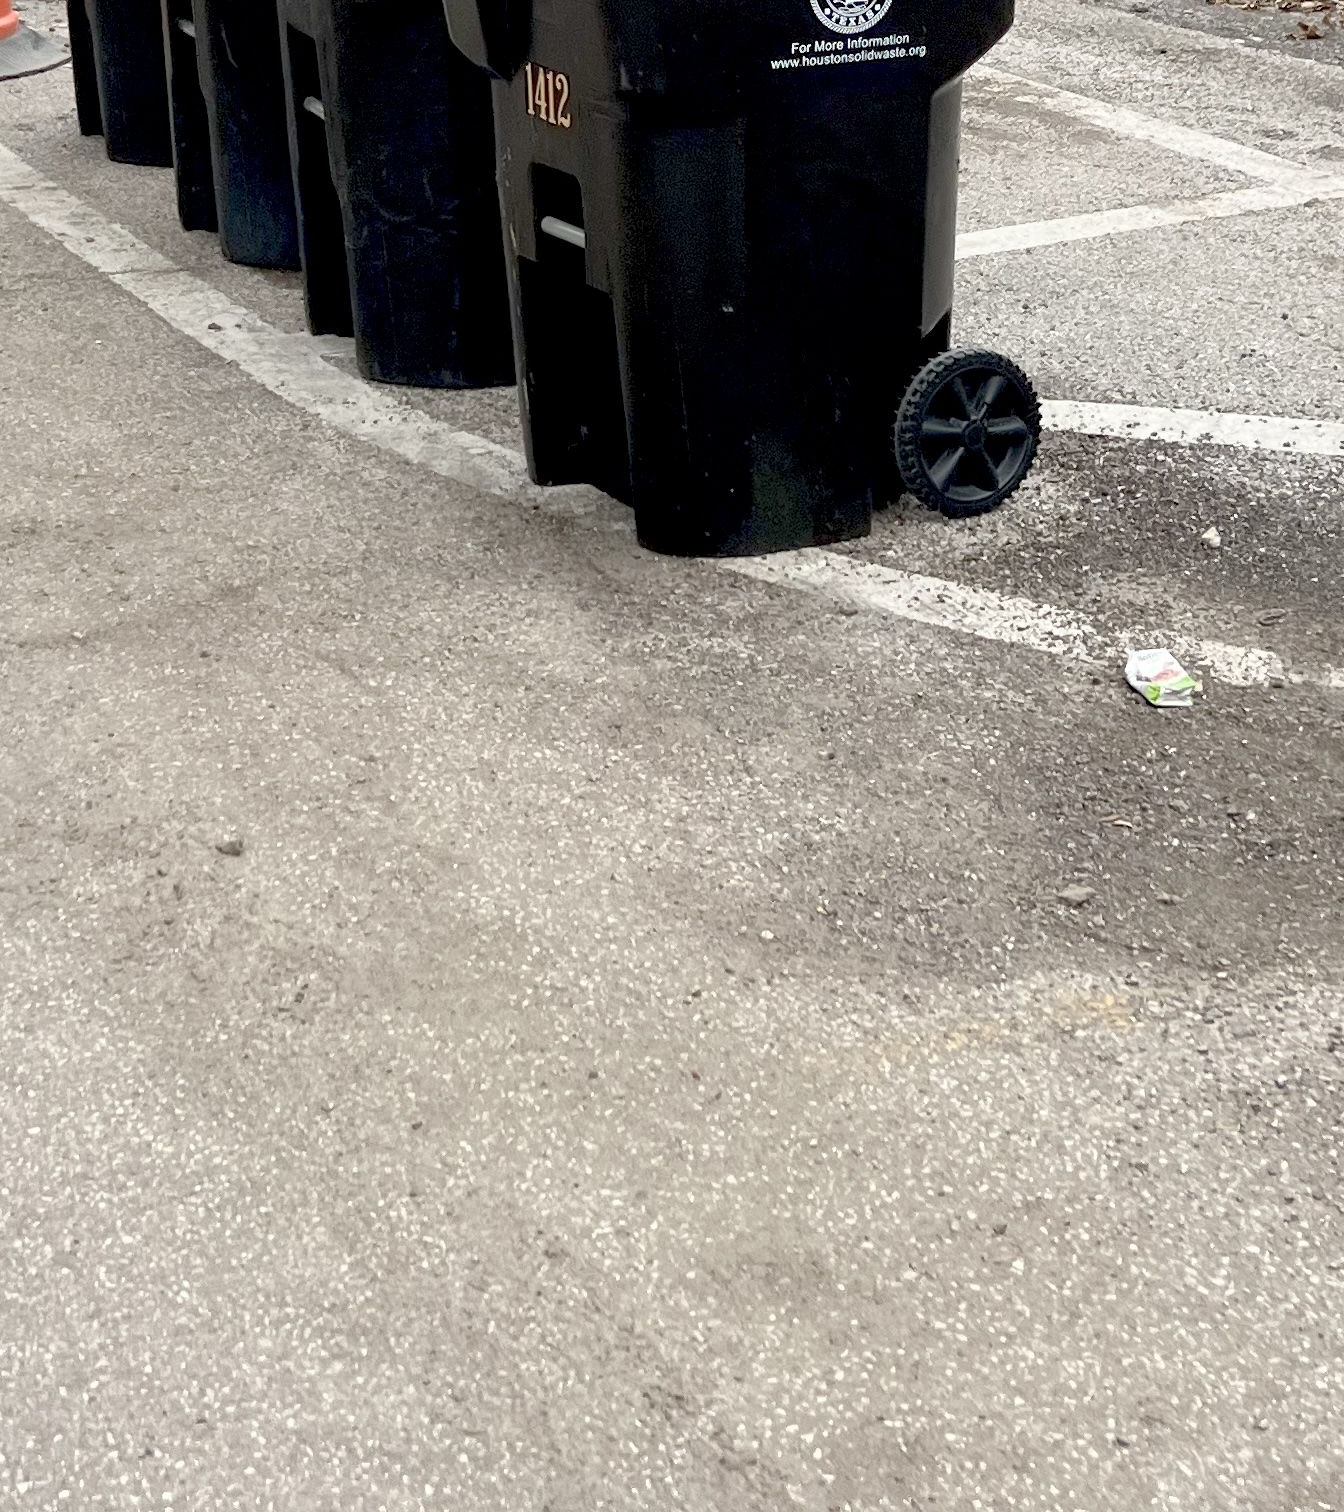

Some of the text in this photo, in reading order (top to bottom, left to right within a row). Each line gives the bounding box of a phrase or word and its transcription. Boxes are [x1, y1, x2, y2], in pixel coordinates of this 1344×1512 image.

[831, 10, 874, 27] TEXAS
[791, 34, 910, 55] For More Information
[771, 45, 927, 70] www.houstonsolidwaste.org
[524, 61, 572, 129] 1412
